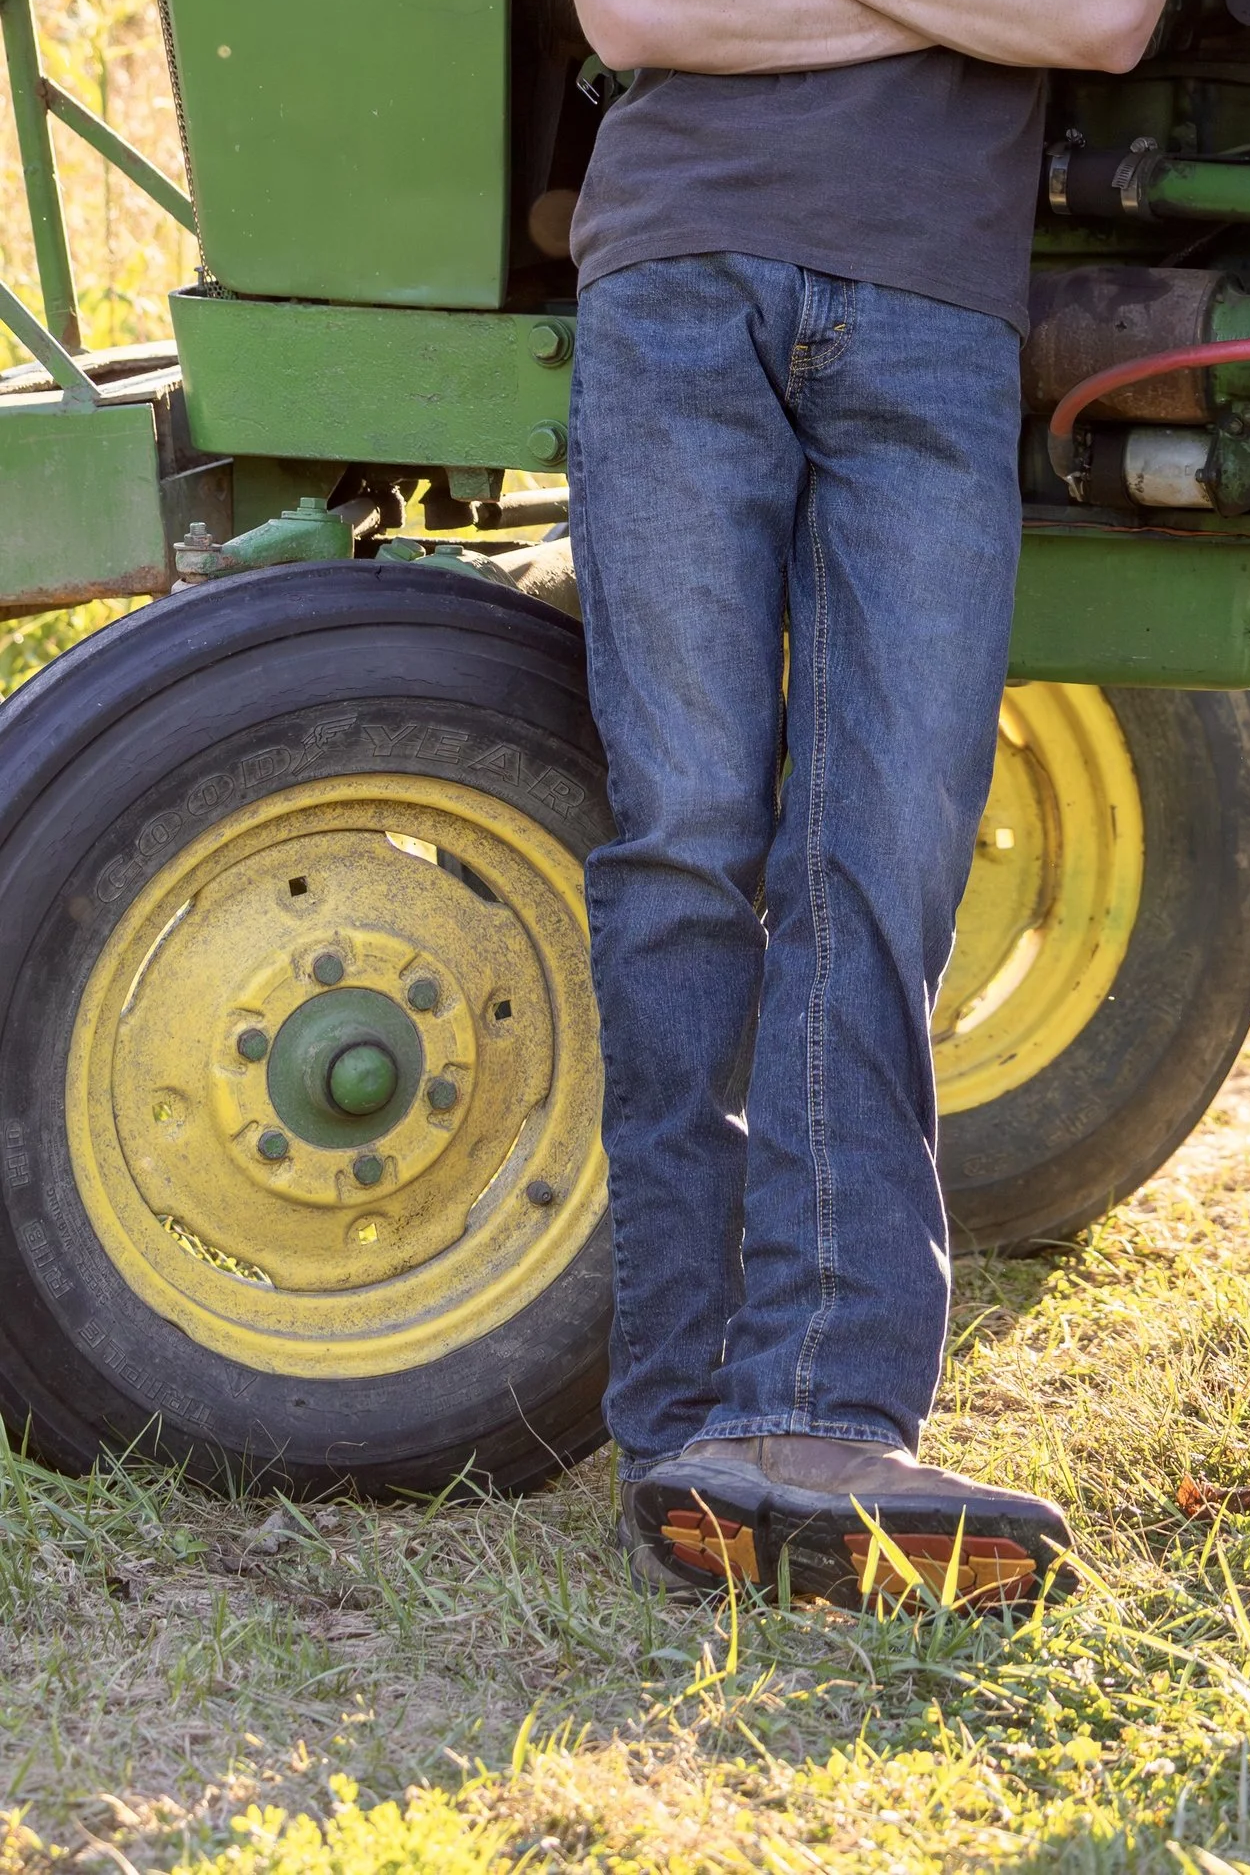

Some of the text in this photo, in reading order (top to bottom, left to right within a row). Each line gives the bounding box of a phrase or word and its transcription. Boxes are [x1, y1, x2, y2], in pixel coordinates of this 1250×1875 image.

[5, 1120, 214, 1429] TRIPLE RIB HD
[47, 1185, 73, 1251] WARNING
